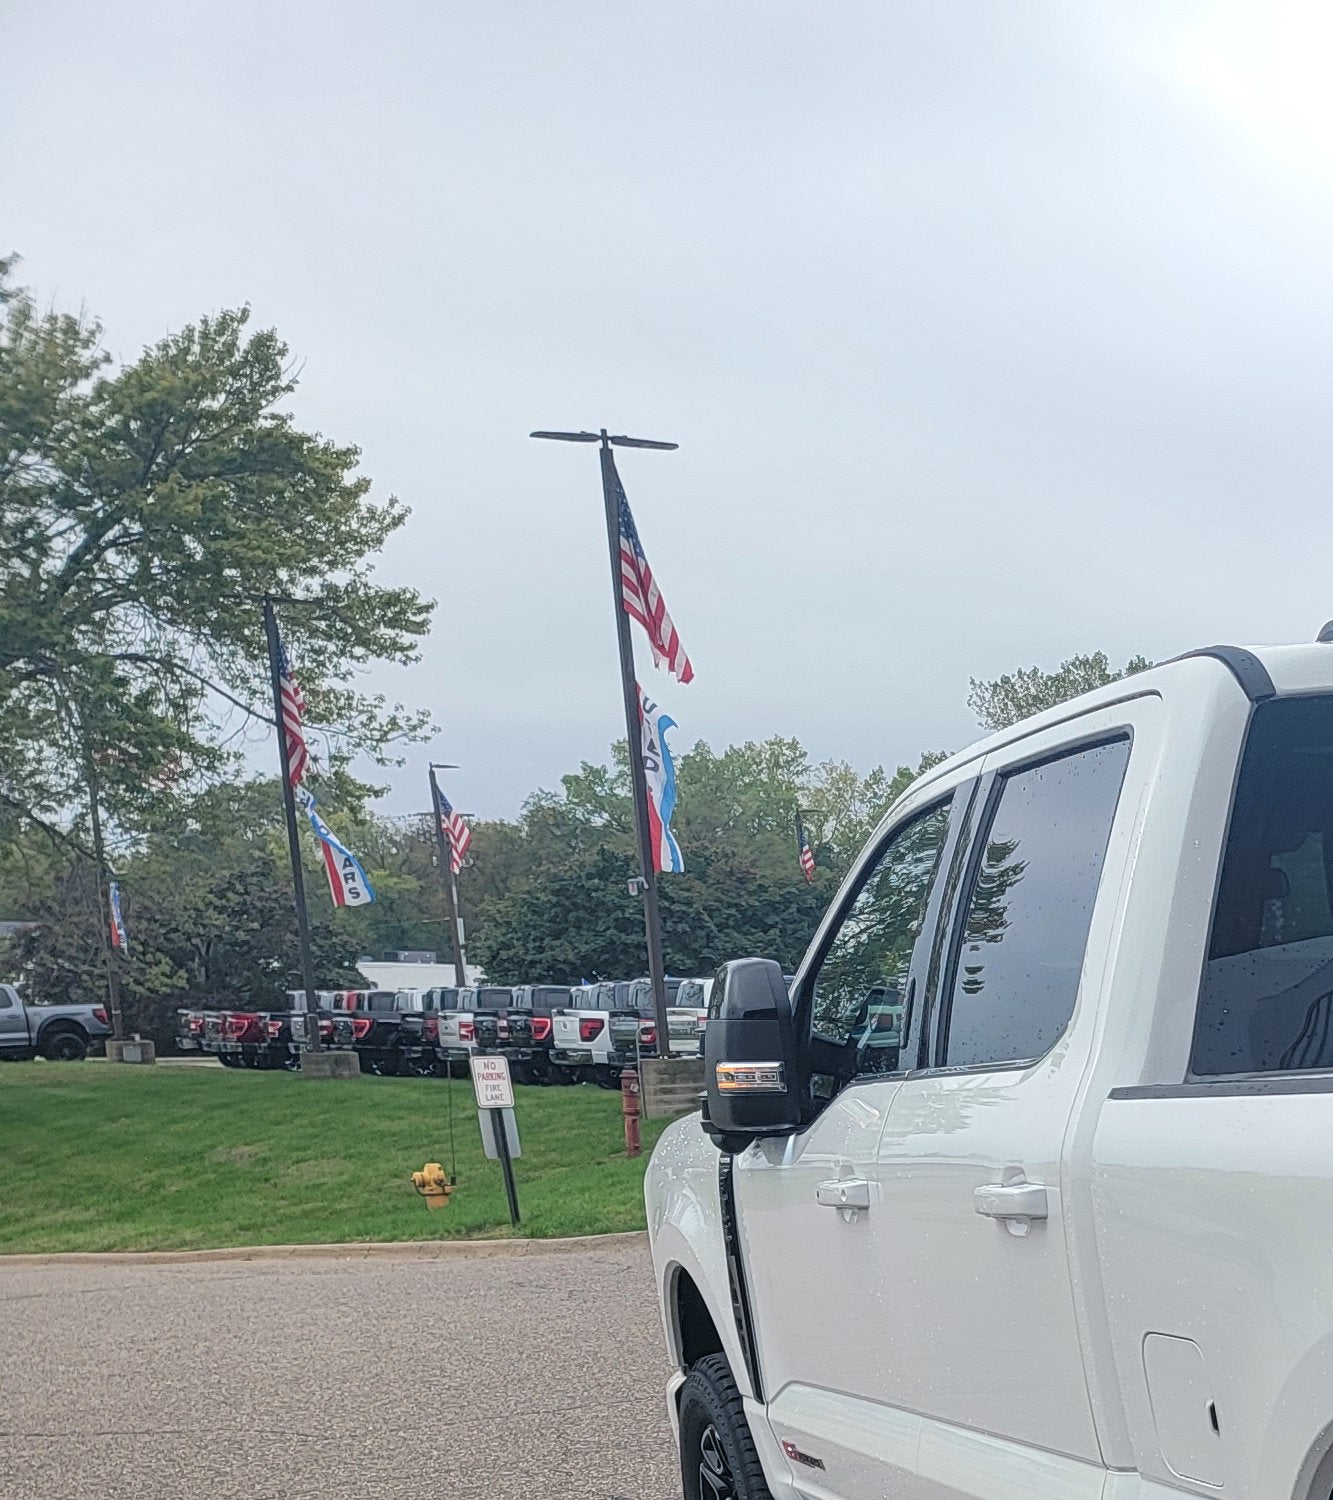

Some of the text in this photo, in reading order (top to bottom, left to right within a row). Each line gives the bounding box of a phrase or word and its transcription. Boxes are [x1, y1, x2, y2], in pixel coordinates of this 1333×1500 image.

[342, 857, 361, 899] ARS
[483, 1061, 496, 1070] NO
[477, 1072, 506, 1081] PARKING
[485, 1084, 502, 1092] FIRE
[485, 1093, 504, 1101] LANE
